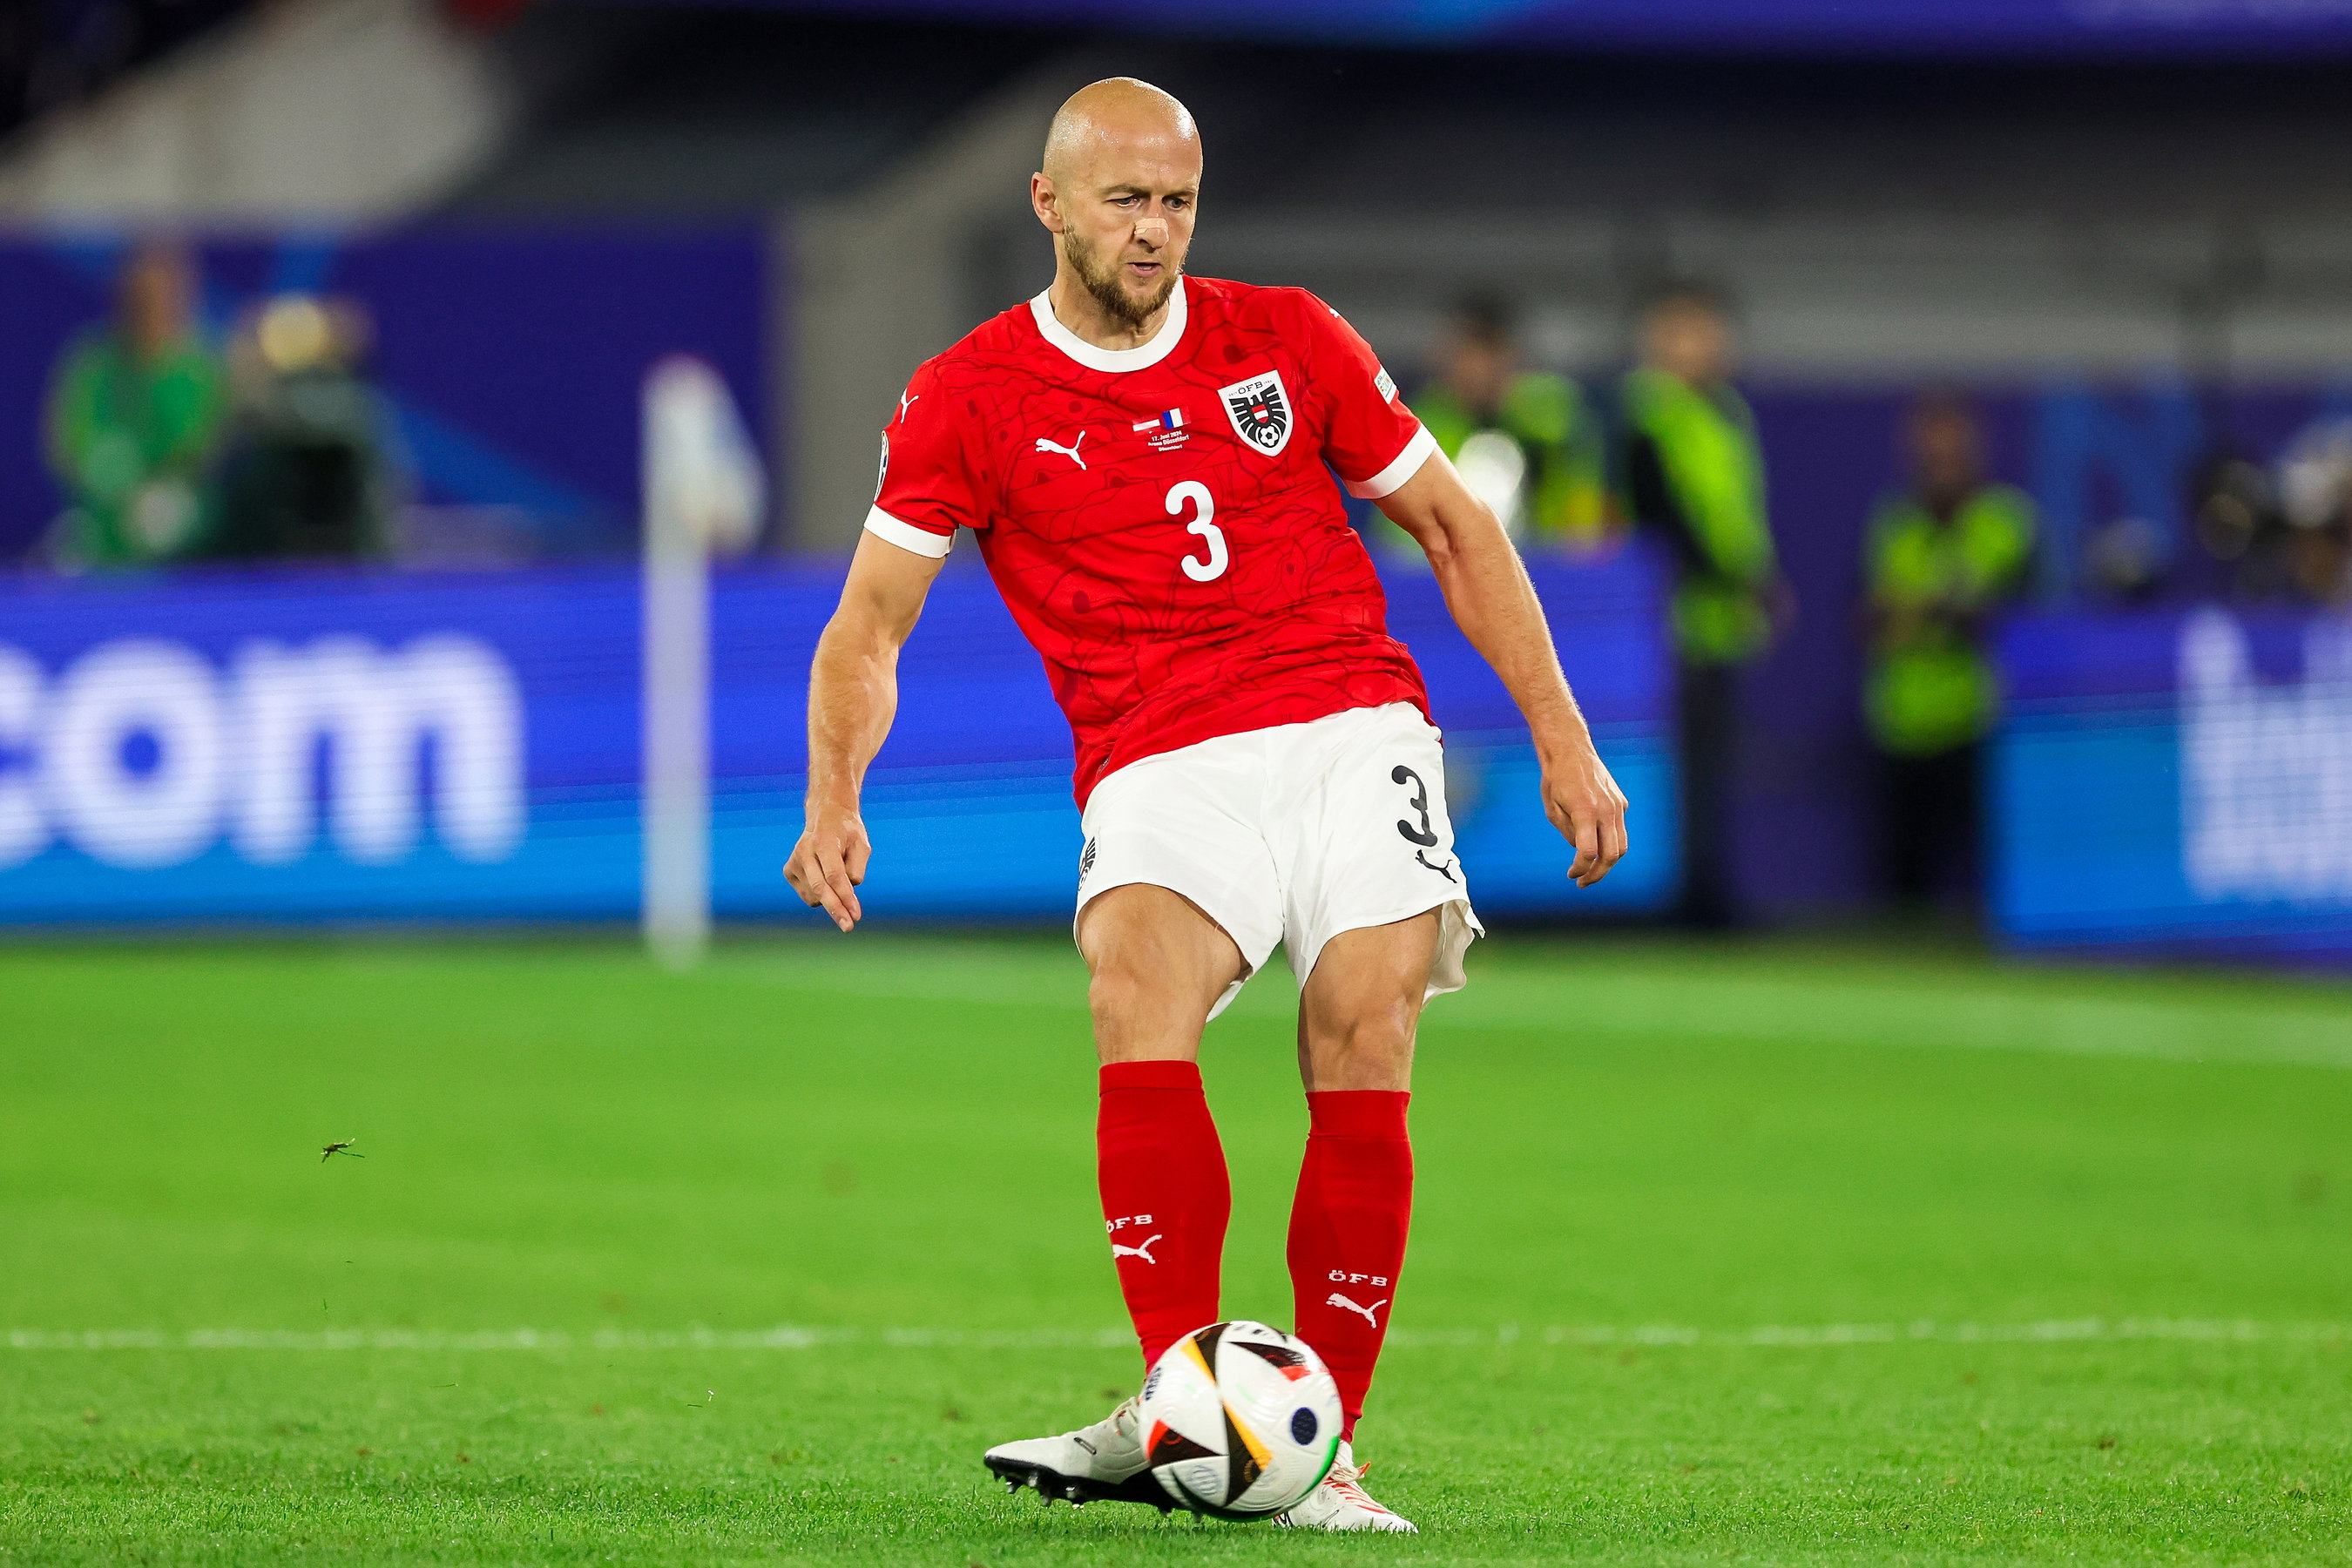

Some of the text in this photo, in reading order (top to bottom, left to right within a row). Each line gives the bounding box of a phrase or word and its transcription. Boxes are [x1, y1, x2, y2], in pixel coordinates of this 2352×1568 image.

[1238, 381, 1263, 395] ÖFB
[1166, 481, 1228, 582] 3
[1391, 765, 1438, 848] 3
[1328, 1269, 1388, 1287] ÖFB
